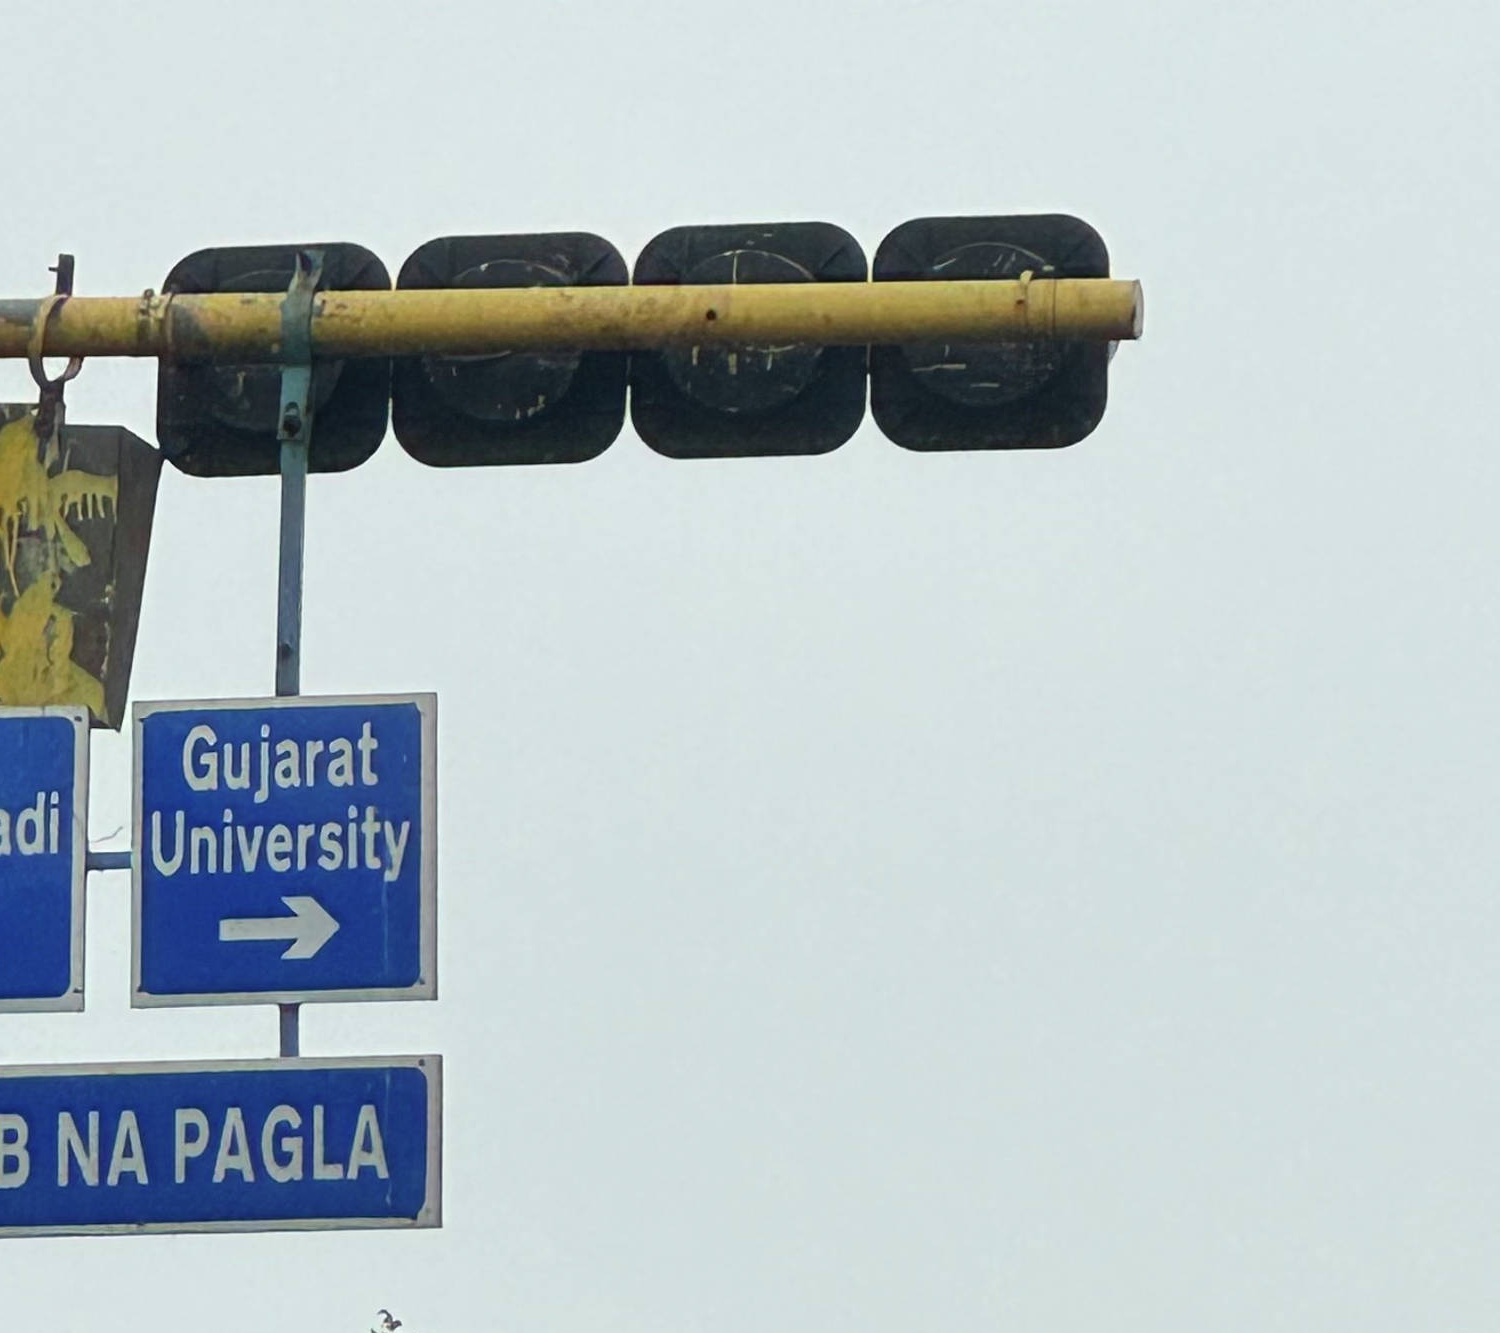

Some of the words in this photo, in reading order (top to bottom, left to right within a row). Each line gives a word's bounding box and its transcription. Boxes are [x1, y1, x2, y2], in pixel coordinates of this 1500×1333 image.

[182, 721, 379, 804] Gujarat
[151, 804, 410, 882] University
[57, 1110, 149, 1187] NA
[174, 1104, 389, 1183] PAGLA
